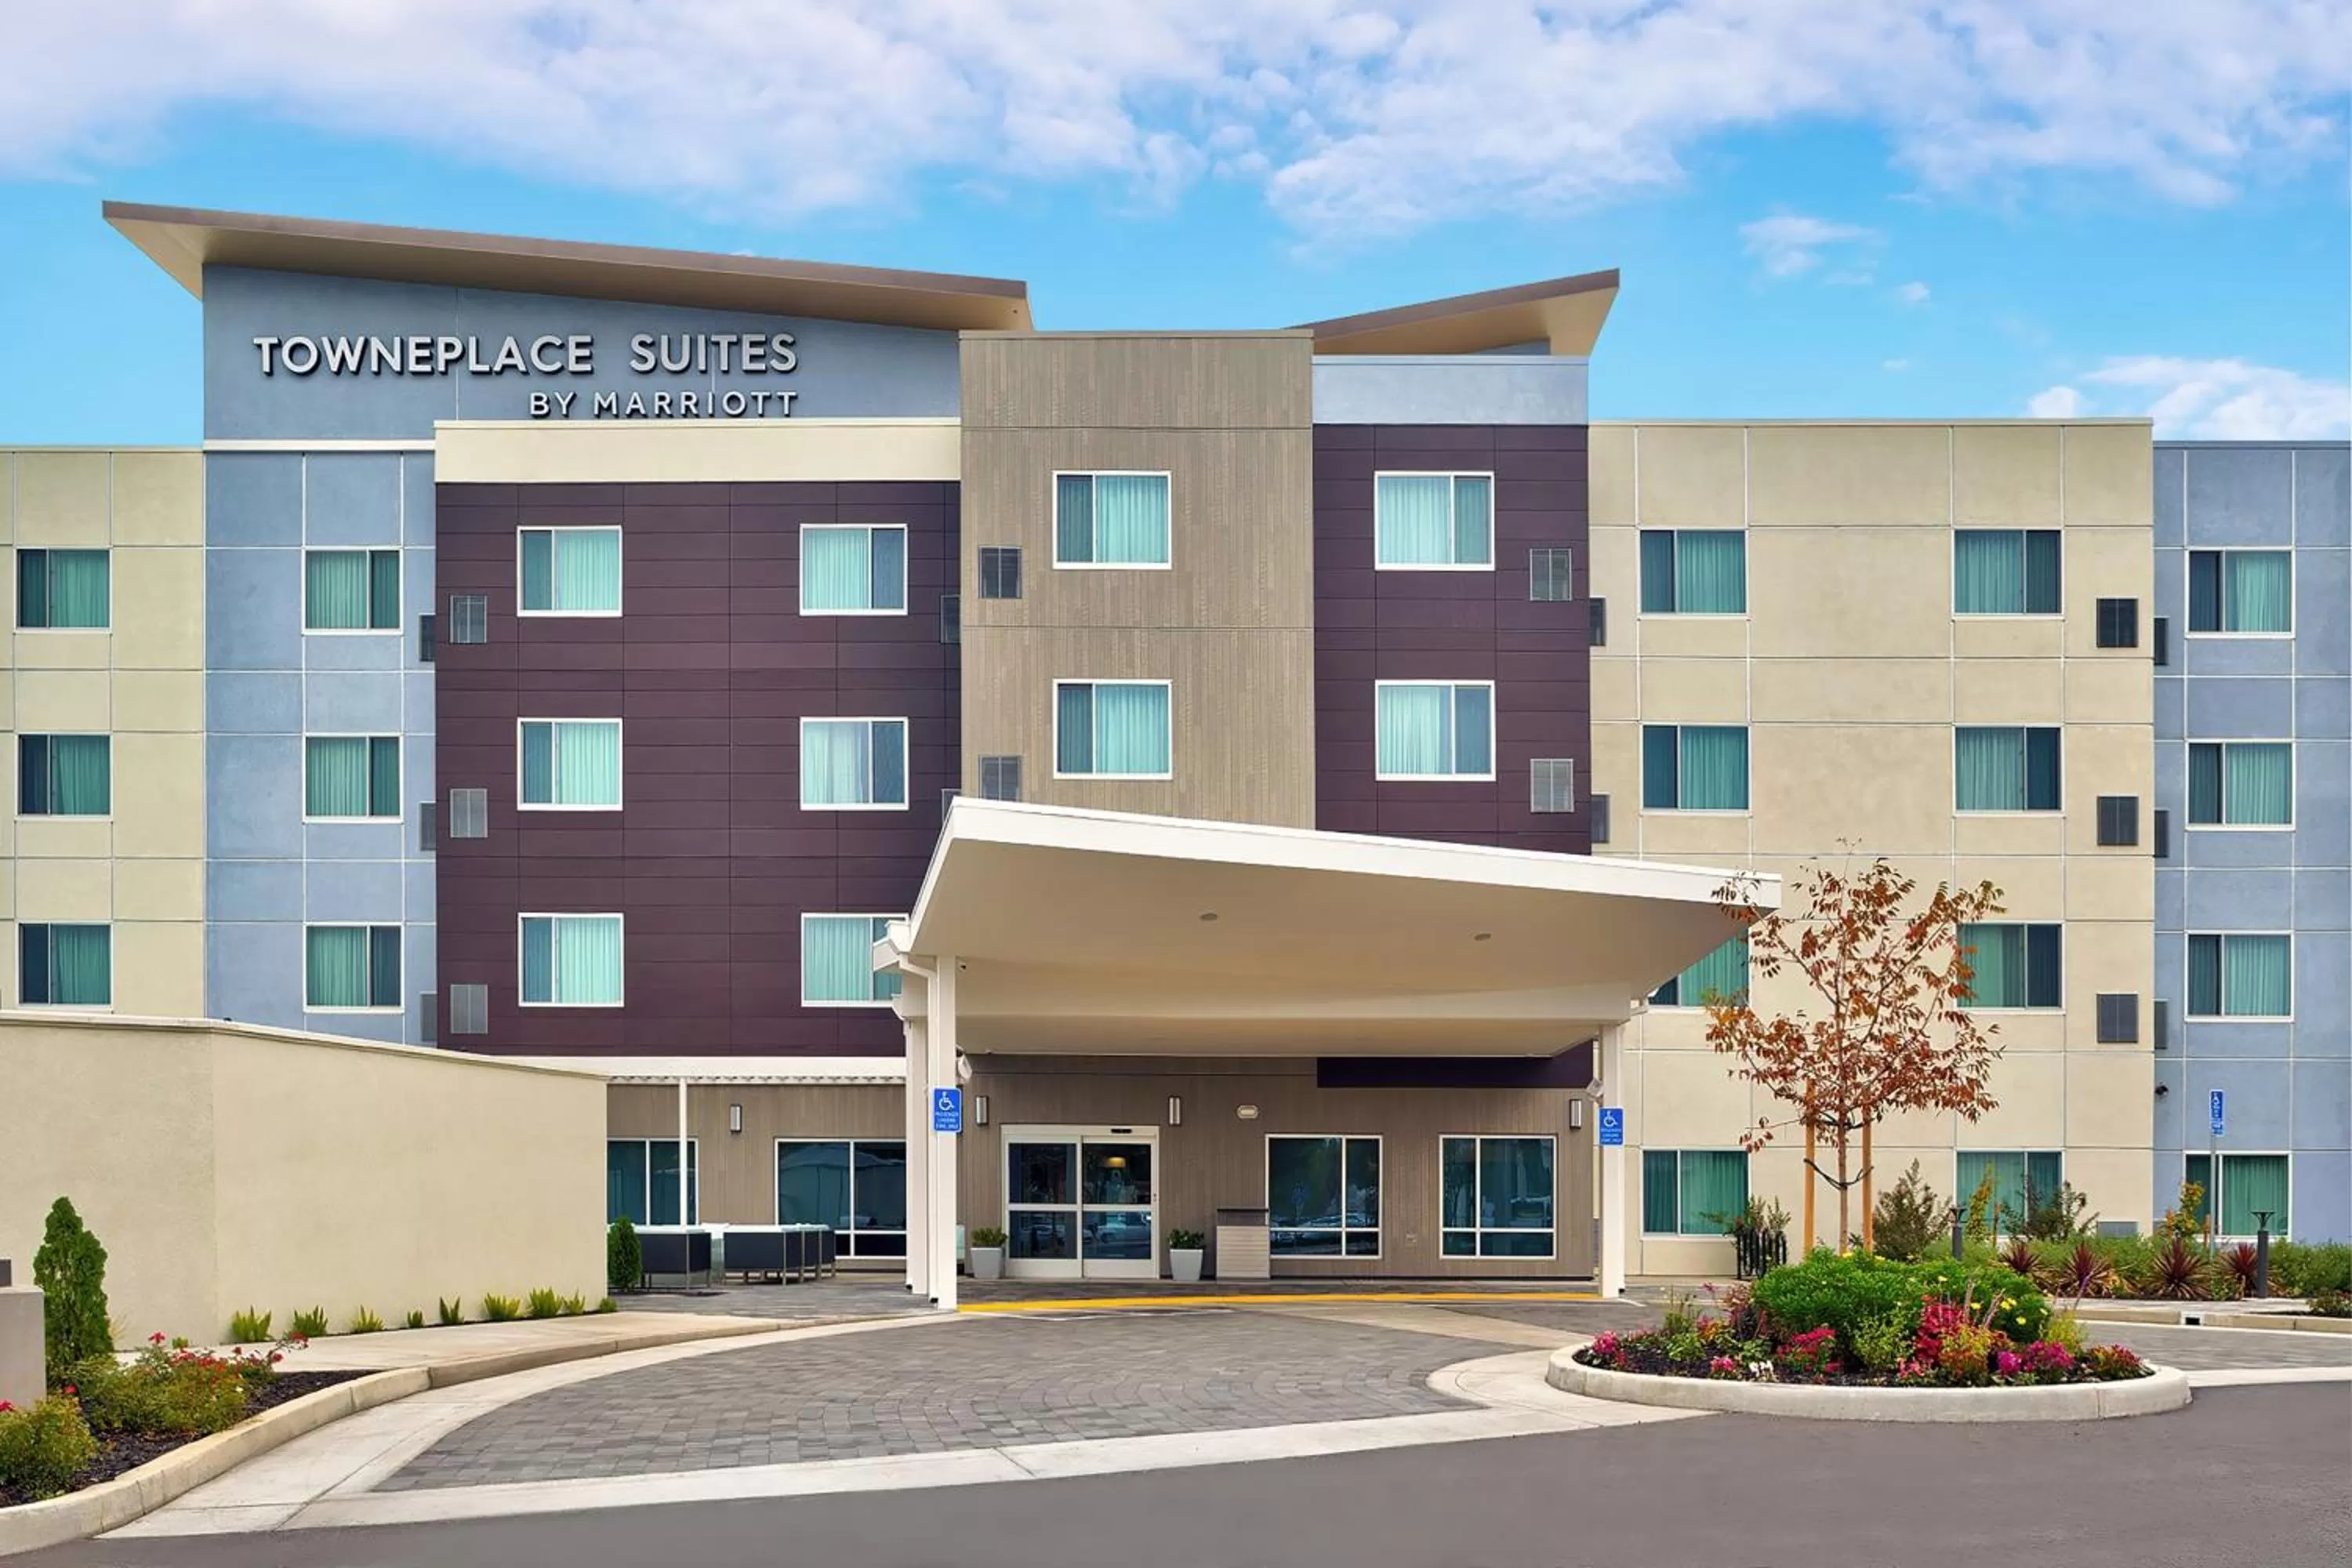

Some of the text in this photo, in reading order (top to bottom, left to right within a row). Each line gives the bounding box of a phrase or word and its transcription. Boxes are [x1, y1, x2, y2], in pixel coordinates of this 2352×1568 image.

[252, 333, 797, 374] TOWNEPLACE SUITES
[529, 390, 797, 416] BY MARRIOTT
